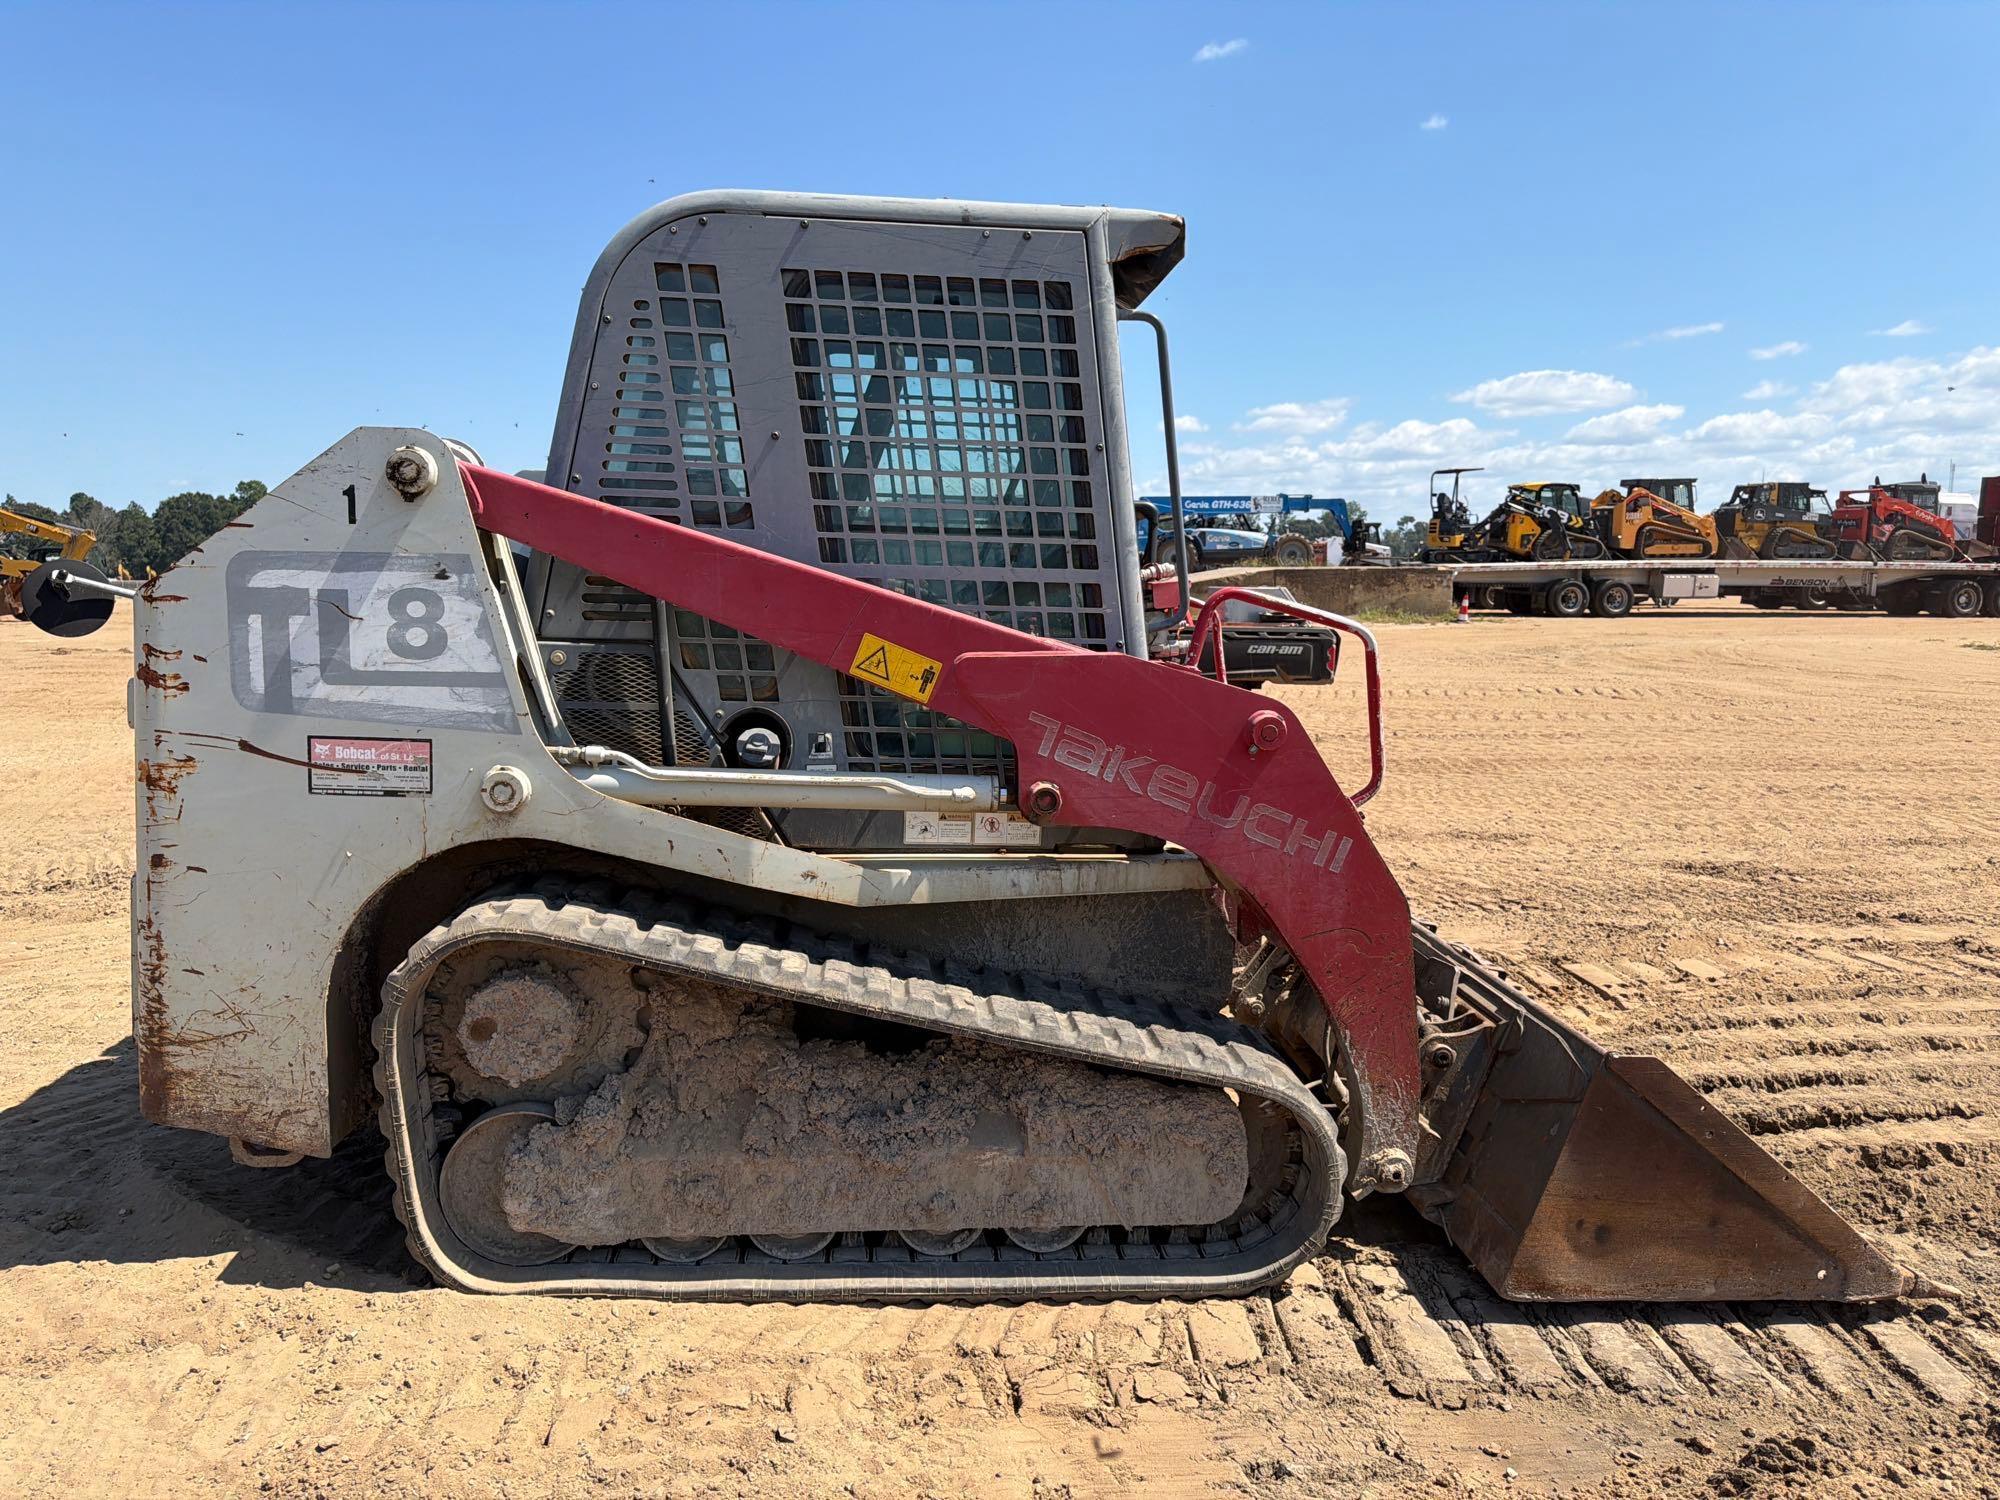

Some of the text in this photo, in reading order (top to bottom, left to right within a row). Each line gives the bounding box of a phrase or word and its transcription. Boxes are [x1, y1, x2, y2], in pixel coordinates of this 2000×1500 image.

[342, 484, 357, 524] 1
[1184, 500, 1251, 509] Genie GTH-636
[1206, 534, 1231, 543] Genie
[1247, 645, 1304, 655] can-am
[335, 746, 376, 760] Bobcat
[341, 762, 370, 771] Service
[377, 764, 397, 772] Parts
[403, 764, 428, 773] Rental
